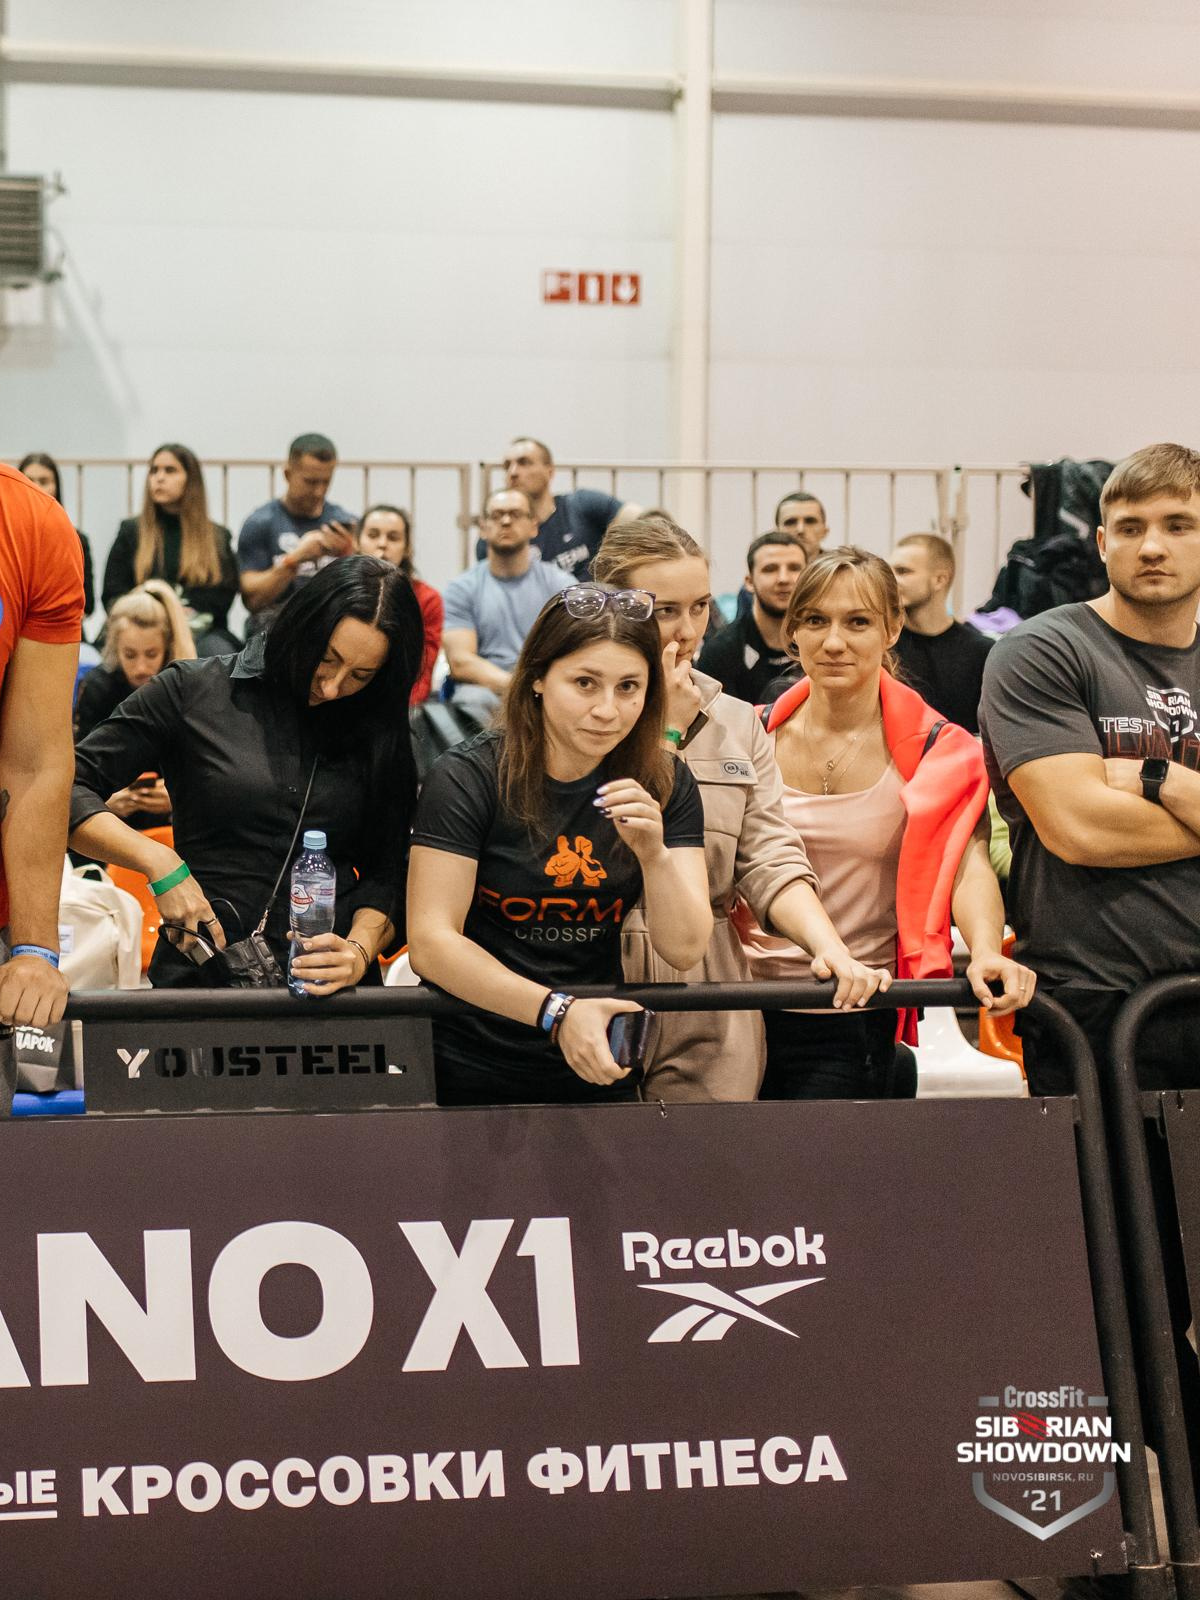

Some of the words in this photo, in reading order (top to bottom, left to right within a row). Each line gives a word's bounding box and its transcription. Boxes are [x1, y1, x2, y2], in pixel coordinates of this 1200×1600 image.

[1146, 689, 1191, 708] SIBRIAN
[1098, 716, 1156, 736] TEST
[479, 884, 624, 924] FORM
[514, 926, 607, 943] CROSSF
[621, 1226, 827, 1279] Reebok
[397, 1216, 581, 1373] X1
[80, 1449, 506, 1518] КРОССОВКИ
[526, 1434, 848, 1495] ФИТНЕСА
